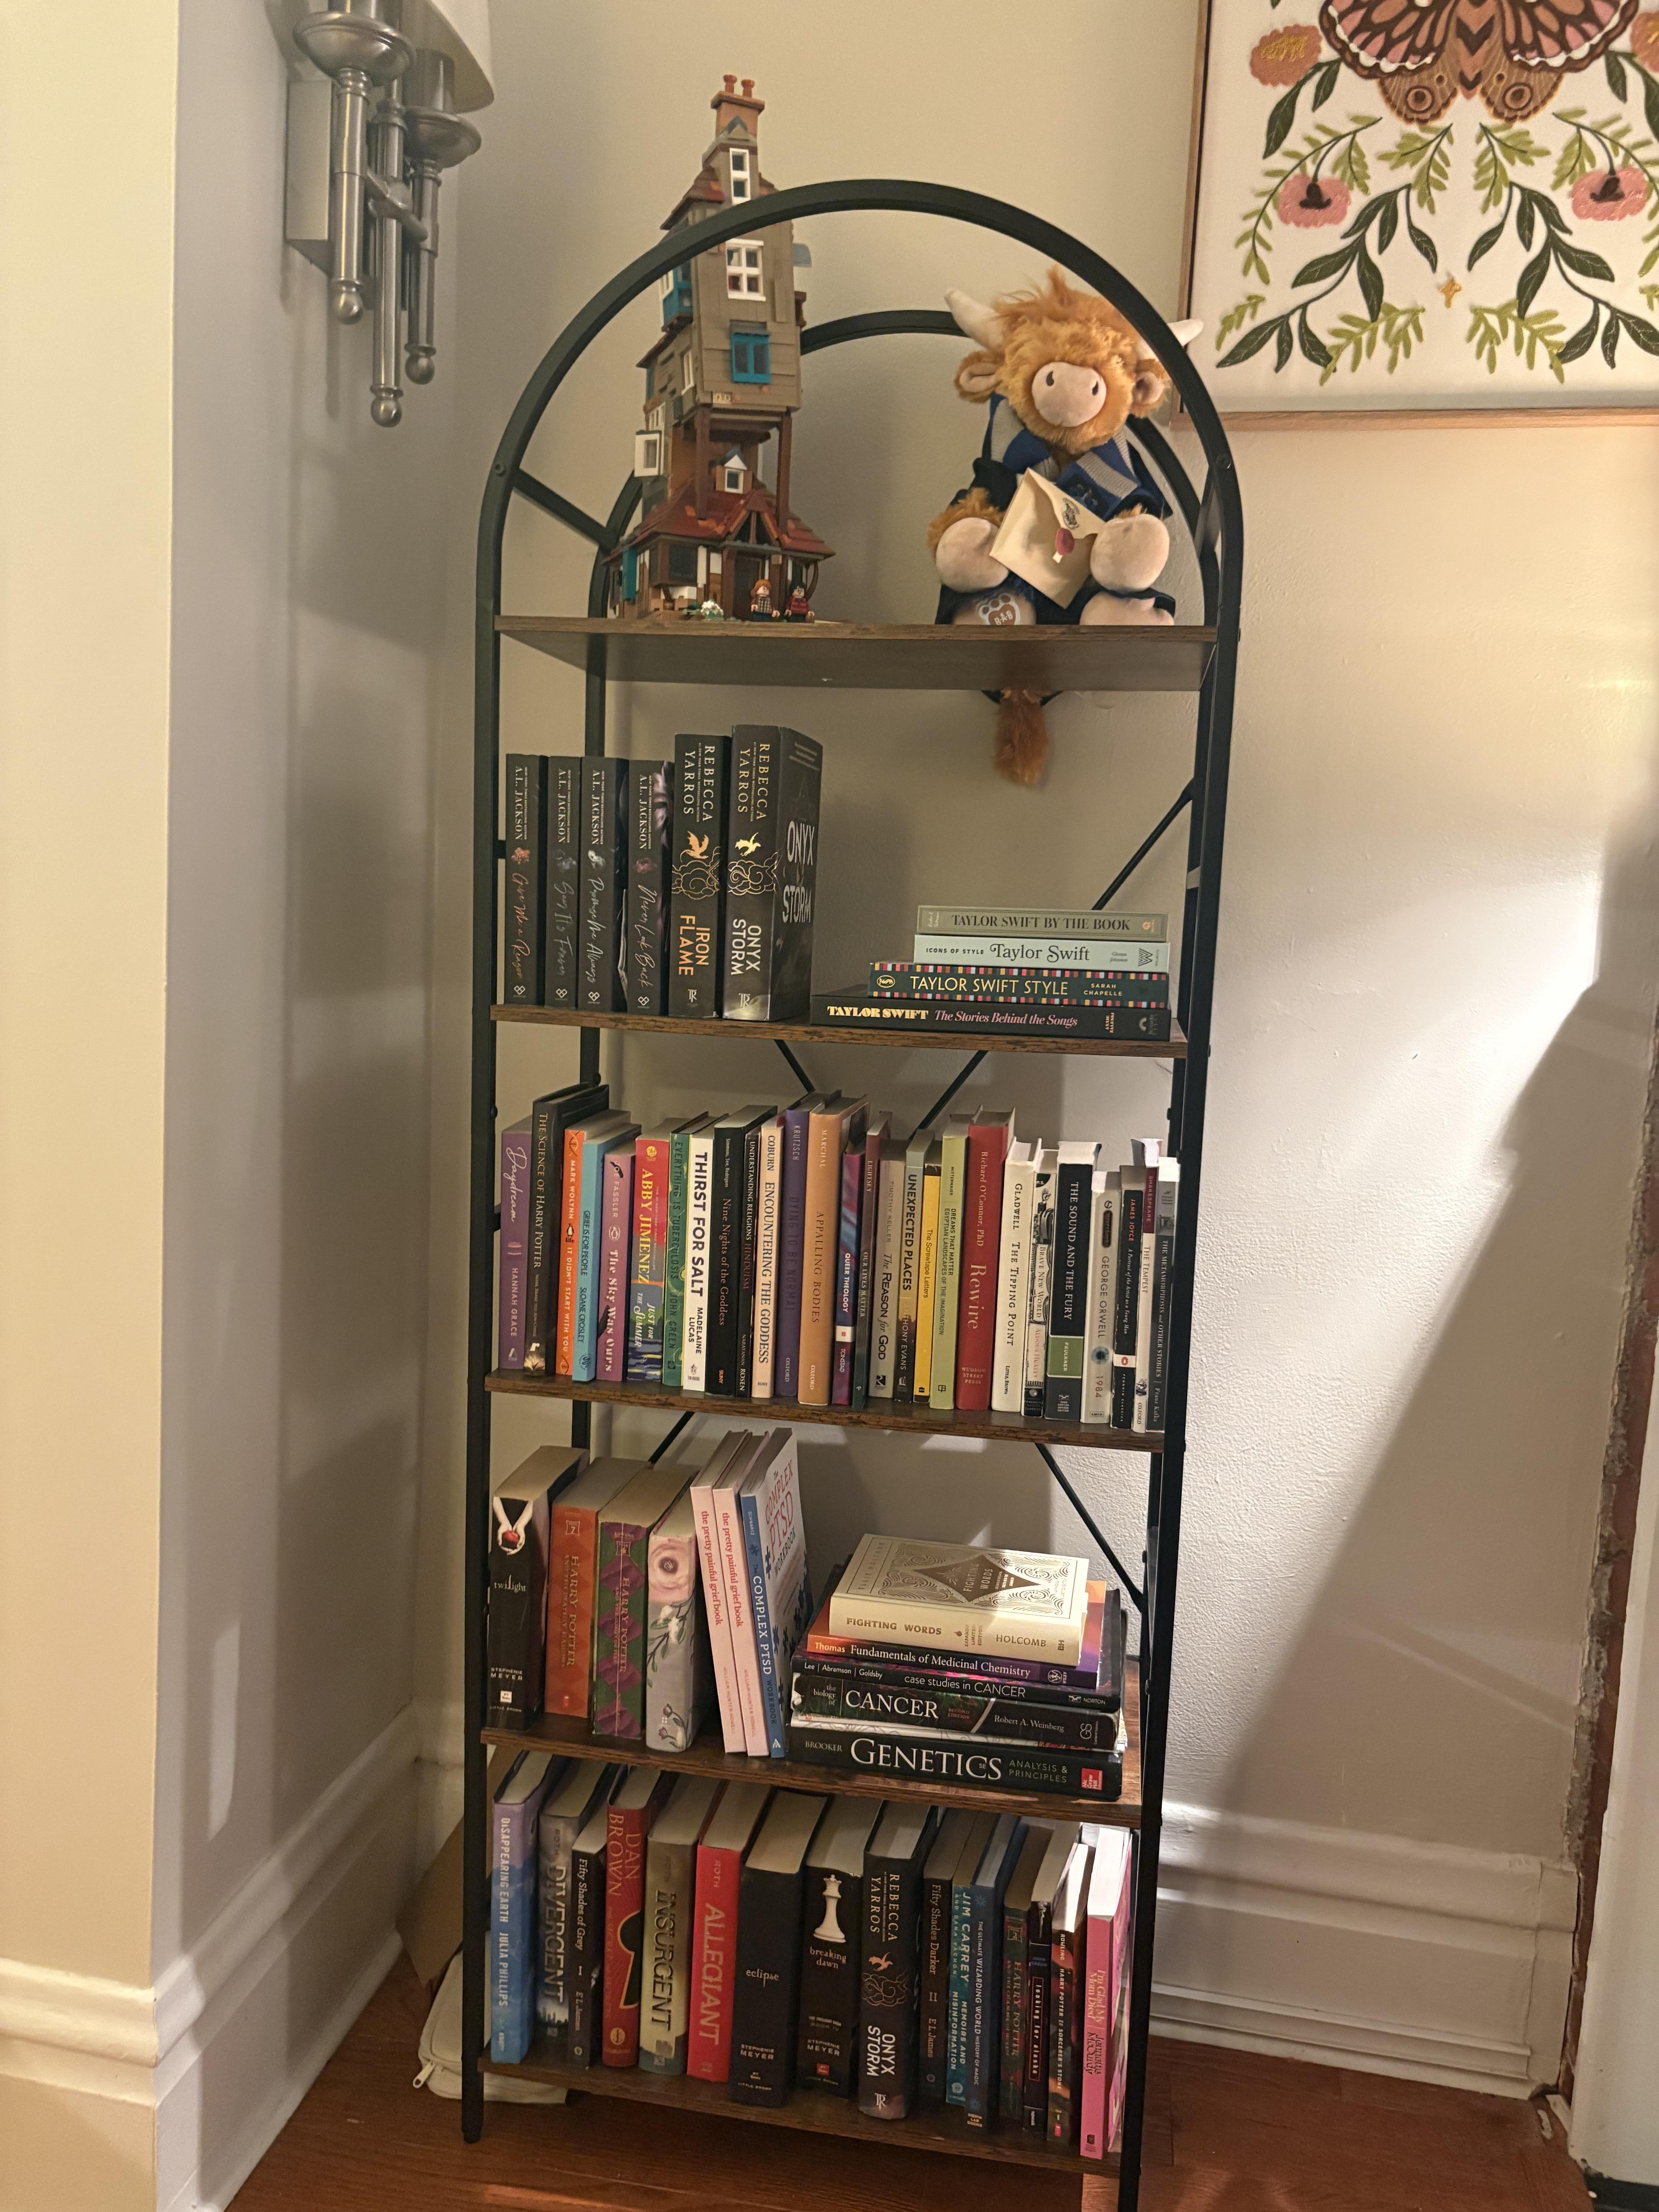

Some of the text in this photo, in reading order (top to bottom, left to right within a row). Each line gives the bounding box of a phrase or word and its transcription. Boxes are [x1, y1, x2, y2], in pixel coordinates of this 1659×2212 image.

[683, 751, 696, 814] YARROS
[702, 745, 715, 821] REBECCA
[737, 749, 750, 813] YARROS
[756, 744, 770, 820] REBECCA
[558, 768, 567, 843] A.L. JACKSON
[591, 769, 601, 845] A.L. JACKSON
[639, 775, 648, 849] A.L. JACKSON
[787, 820, 815, 866] ONYX
[638, 884, 658, 923] Never
[782, 884, 812, 924] STORM
[951, 915, 997, 926] TAYLOR
[1001, 916, 1041, 928] SWIFT
[1044, 918, 1060, 929] BY
[1063, 918, 1089, 929] THE
[1093, 919, 1132, 930] BOOK
[678, 915, 696, 976] FLAME
[696, 927, 711, 965] IRON
[731, 919, 747, 975] STORM
[745, 925, 762, 972] ONYX
[990, 943, 1090, 962] Taylor Swift
[635, 953, 655, 988] Back
[910, 976, 1068, 995] TAYLOR SWIFT STYLE
[827, 1006, 929, 1020] TAYLOR SWIFT
[935, 1010, 1078, 1027] The Stories Behind the Songs
[767, 1136, 775, 1171] COBURN
[503, 1147, 527, 1222] Daydream
[533, 1113, 548, 1268] THE SCIENCE OF HARRY POTTER
[1013, 1183, 1022, 1230] GLADWELL
[637, 1169, 653, 1285] ABBY JIMENEZ
[691, 1152, 708, 1297] THIRST FOR SALT
[903, 1175, 917, 1290] UNEXPECTED PLACES
[759, 1182, 775, 1363] ENCOUNTERING THE GODDESS
[812, 1212, 824, 1322] APPALLING BODIES
[1064, 1182, 1079, 1320] THE SOUND AND THE FURY
[967, 1264, 987, 1329] Rewire
[1007, 1242, 1020, 1346] THE TIPPING POINT
[1100, 1256, 1109, 1297] GEORGE
[878, 1254, 893, 1360] The REASON for GOD
[1098, 1300, 1107, 1338] ORWELL
[696, 1307, 704, 1354] MADELAINE
[1095, 1376, 1103, 1398] 1984
[494, 1574, 526, 1592] twilight
[701, 1511, 723, 1625] the pretty painful grief book
[566, 1556, 579, 1666] HARRY POTTER
[753, 1576, 772, 1674] COMPLEX PTSD
[846, 1618, 942, 1635] FIGHTING WORDS
[815, 1642, 845, 1653] Thomas
[850, 1645, 1031, 1677] Fundamentals of Medicinal Chemistry
[996, 1635, 1046, 1647] HOLCOMB
[490, 1673, 522, 1681] MEYER
[804, 1662, 815, 1670] Lee
[822, 1664, 852, 1674] Abramson
[859, 1669, 883, 1680] Goldsby
[905, 1676, 1025, 1698] case studies in CANCER
[813, 1689, 836, 1700] biology
[846, 1690, 939, 1719] CANCER
[805, 1741, 842, 1752] BROOKER
[994, 1715, 1018, 1725] Robert
[1030, 1720, 1065, 1733] Weinberg
[851, 1738, 1002, 1781] GENETICS
[1009, 1759, 1057, 1772] ANALYSIS
[1009, 1769, 1067, 1783] PRINCIPLES
[499, 1817, 510, 1923] DISAPPEARING EARTH
[607, 1814, 624, 1898] BROWN
[625, 1833, 641, 1879] DAN
[713, 1860, 721, 1887] ROTH
[575, 1858, 588, 1950] Fifty Shades of Grey
[870, 1877, 881, 1933] YARROS
[888, 1874, 900, 1941] REBECCA
[544, 1865, 566, 2002] DIVERGENT
[809, 1946, 847, 1964] breaking
[960, 1893, 971, 1983] JIM CARREY
[498, 1932, 509, 2006] JULIA PHILLIPS
[651, 1890, 677, 2031] INSURGENT
[698, 1903, 725, 2045] ALLEGIANT
[745, 1968, 780, 1988] eclipse
[816, 1958, 839, 1970] dawn
[866, 2025, 881, 2076] STORM
[881, 2034, 896, 2075] ONYX
